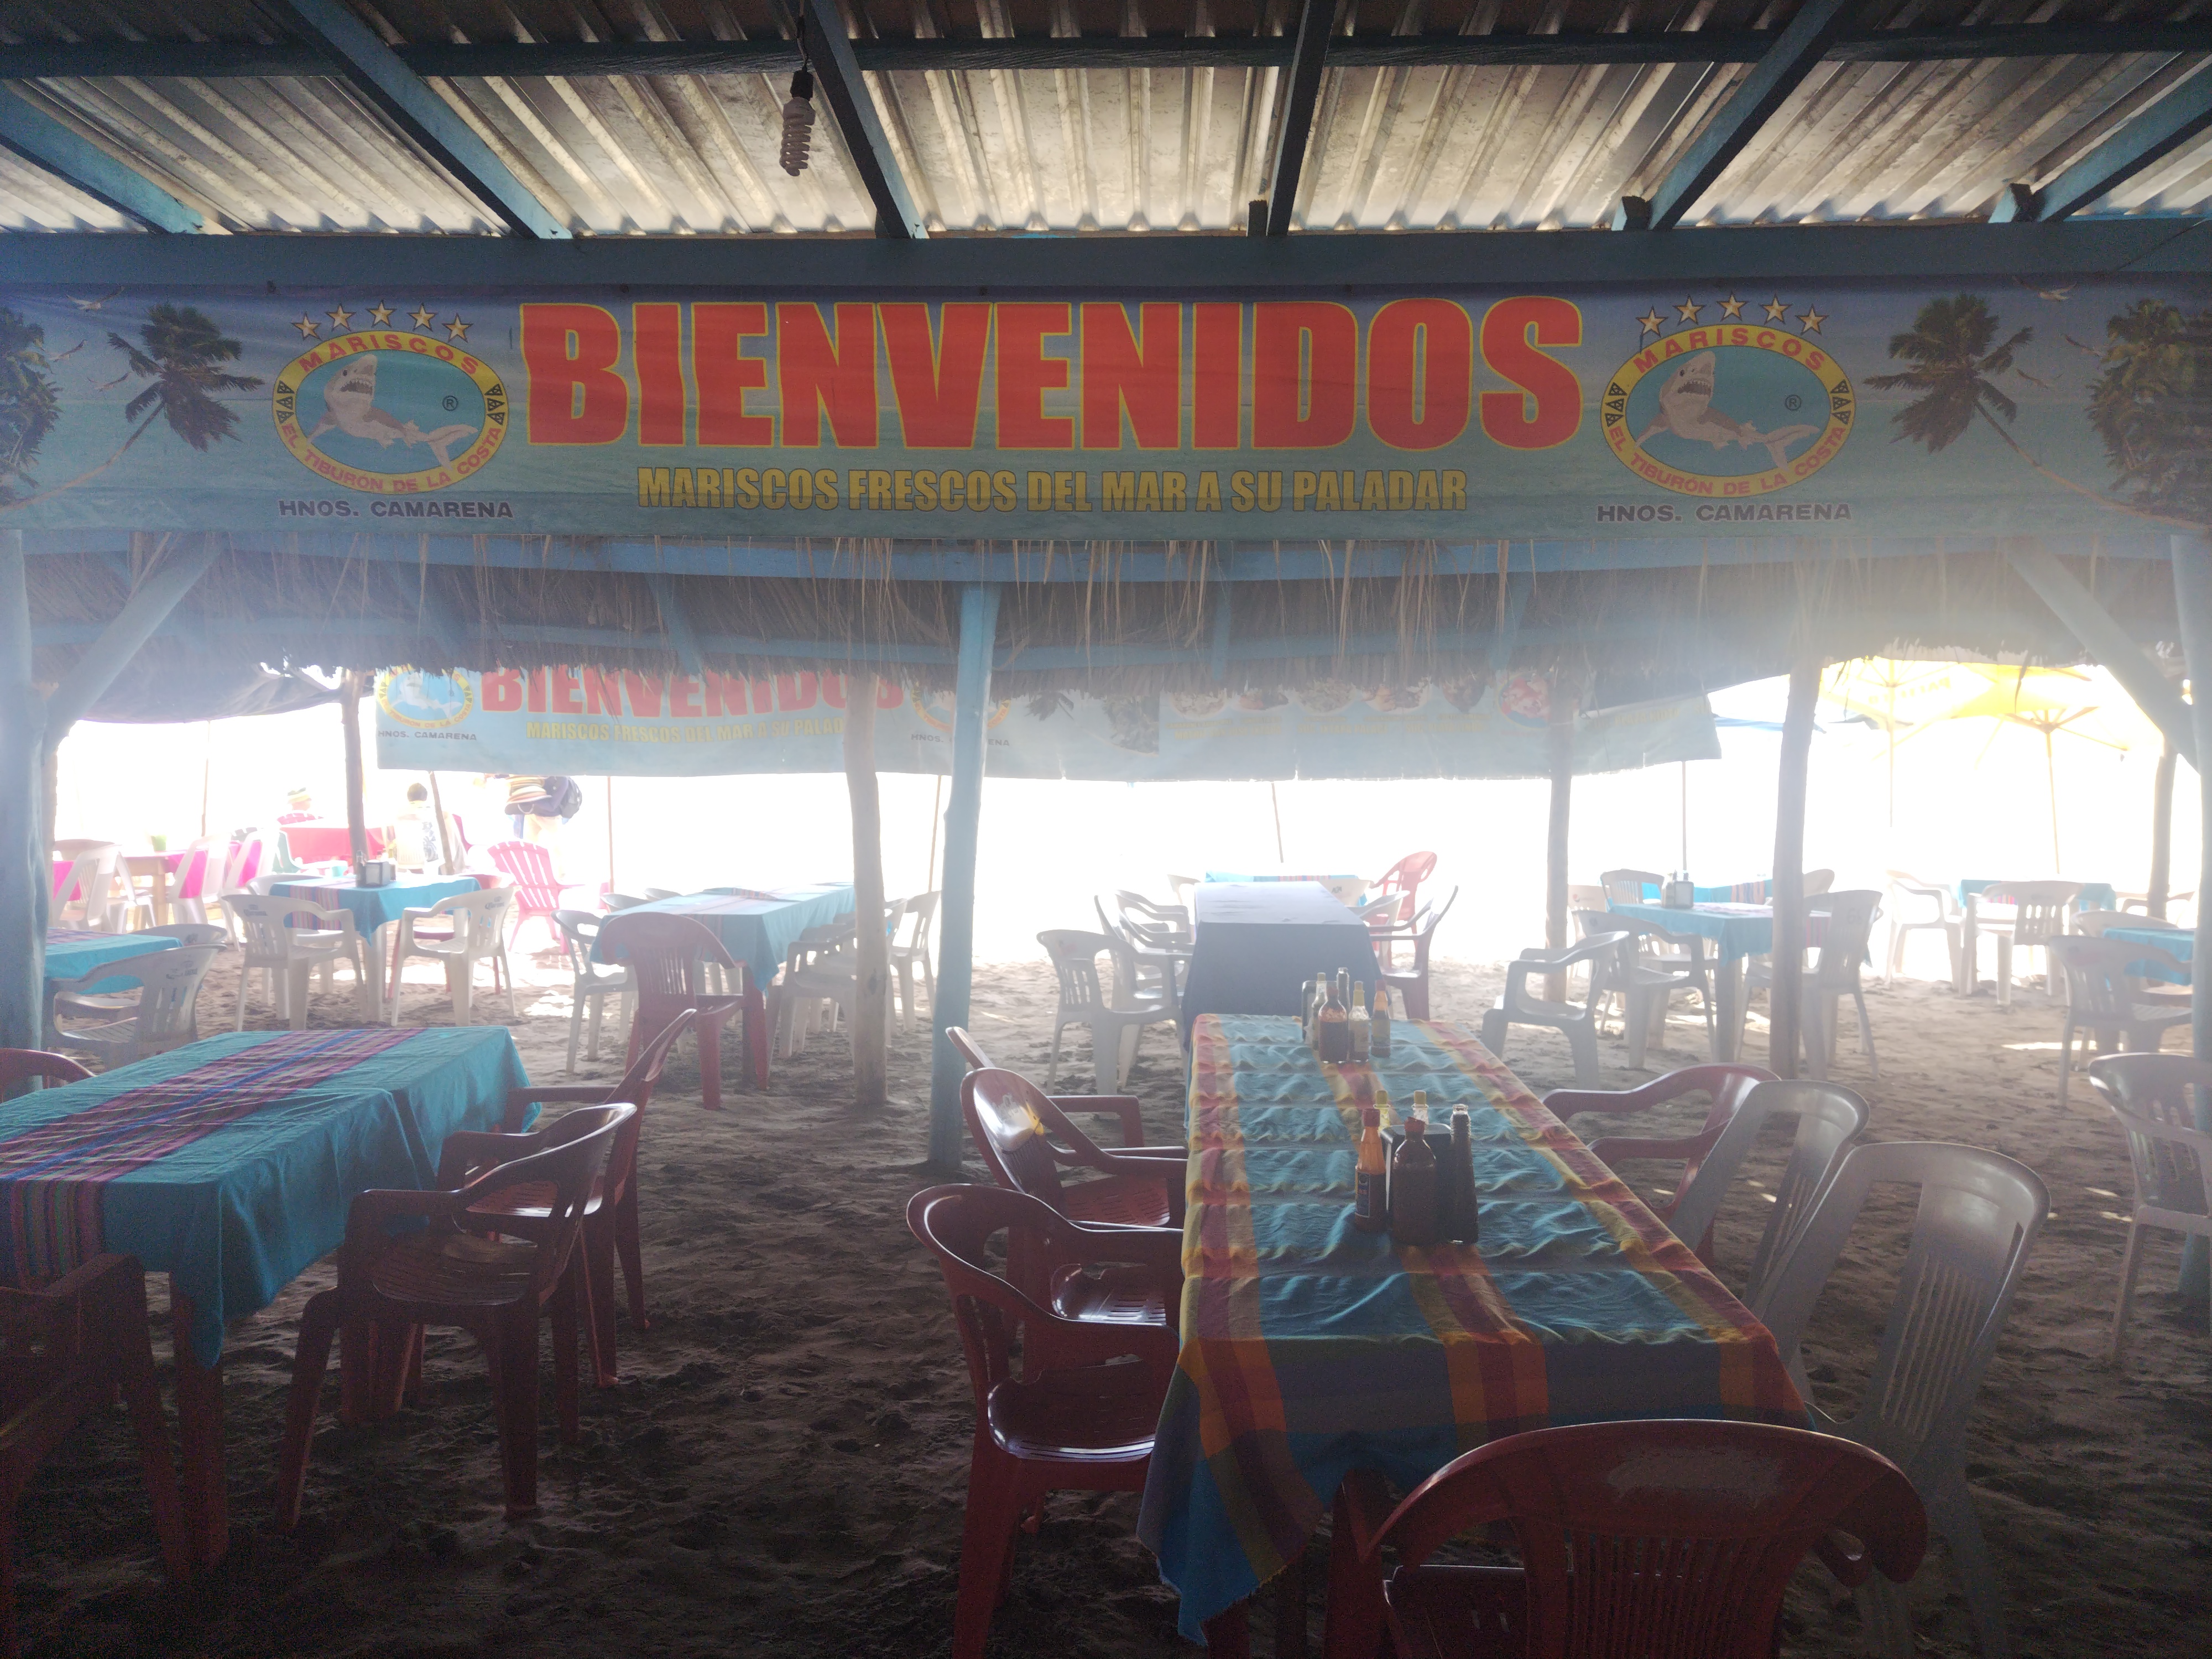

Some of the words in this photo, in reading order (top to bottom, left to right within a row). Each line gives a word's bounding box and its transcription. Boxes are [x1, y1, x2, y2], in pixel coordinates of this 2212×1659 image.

[299, 333, 478, 375] MARISCOS
[1632, 327, 1825, 373] MARISCOS
[519, 296, 1583, 451] BIENVENIDOS
[281, 423, 297, 448] EL
[393, 478, 418, 493] DE
[427, 471, 452, 488] LA
[457, 427, 502, 475] COSTA
[1608, 426, 1623, 452] EL
[1723, 481, 1751, 495] DE
[1760, 473, 1788, 490] LA
[1794, 426, 1846, 476] COSTA
[279, 500, 359, 518] HNOS.
[370, 500, 514, 519] CAMARENA
[637, 467, 839, 510] MARISCOS
[848, 469, 1018, 512] FRESCOS
[1027, 471, 1092, 512] DEL
[1101, 471, 1187, 512] MAR
[1196, 471, 1223, 512] A
[1230, 469, 1283, 513] SU
[1292, 469, 1468, 512] PALADAR
[1597, 504, 1682, 523] HNOS.
[1695, 503, 1853, 521] CAMARENA
[414, 731, 477, 741] CAMARENA
[526, 721, 609, 741] MARISCOS
[614, 724, 681, 743] FRESCOS
[685, 726, 713, 743] DEL
[717, 723, 753, 741] MAR
[757, 722, 768, 738] A
[771, 719, 791, 737] SU
[794, 717, 845, 735] PALAD
